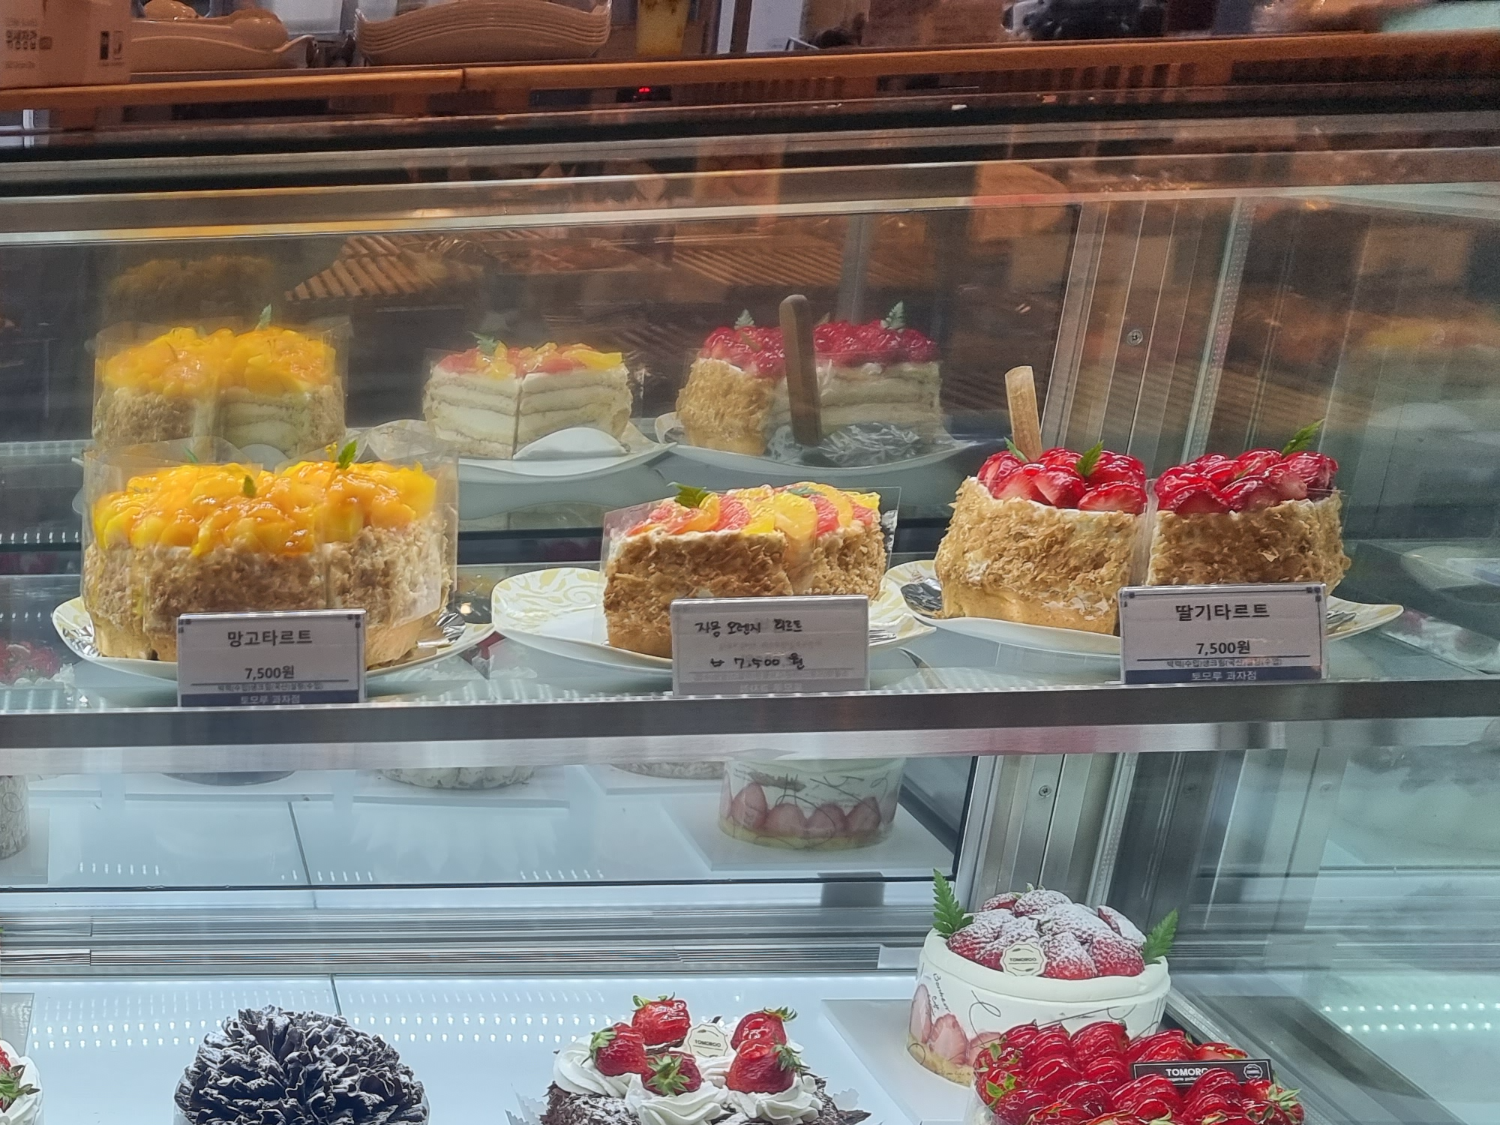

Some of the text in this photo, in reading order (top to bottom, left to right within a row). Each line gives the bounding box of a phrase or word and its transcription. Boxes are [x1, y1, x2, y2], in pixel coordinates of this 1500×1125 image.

[1175, 603, 1271, 622] 딸기타르트
[695, 620, 721, 638] 자몽
[727, 621, 761, 635] 오렌지
[227, 629, 313, 648] 망고타르트
[1196, 640, 1251, 656] 7,500원
[245, 665, 295, 681] 7,500원
[1191, 670, 1257, 681] 토모루 과자점
